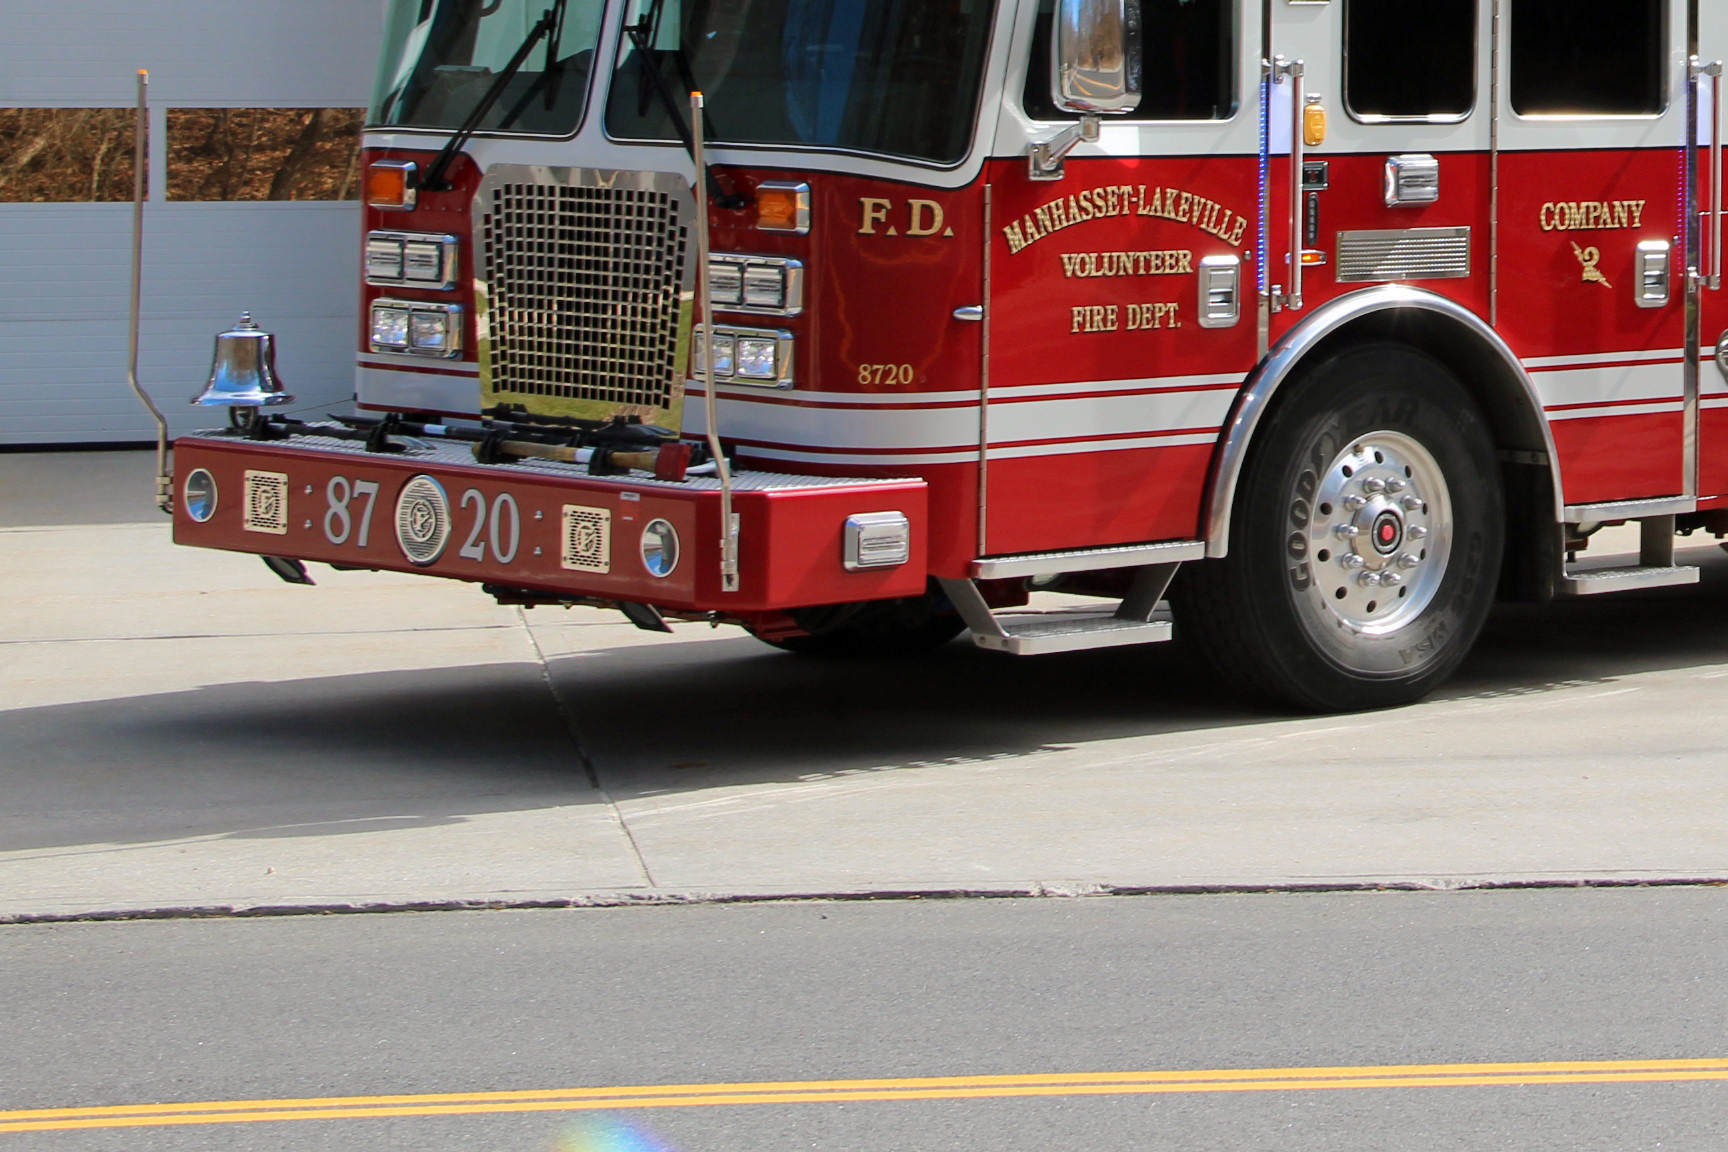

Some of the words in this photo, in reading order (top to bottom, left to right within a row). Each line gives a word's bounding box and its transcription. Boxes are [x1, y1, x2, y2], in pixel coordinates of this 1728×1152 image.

[1002, 184, 1248, 255] MANHASSET-LAKEVILLE
[1539, 199, 1647, 233] COMPANY
[1060, 249, 1194, 279] VOLUNTEER
[1071, 305, 1119, 334] FIRE
[1126, 302, 1181, 332] DEPT.
[857, 364, 914, 385] 8720
[324, 476, 379, 547] 87
[459, 489, 520, 563] 20
